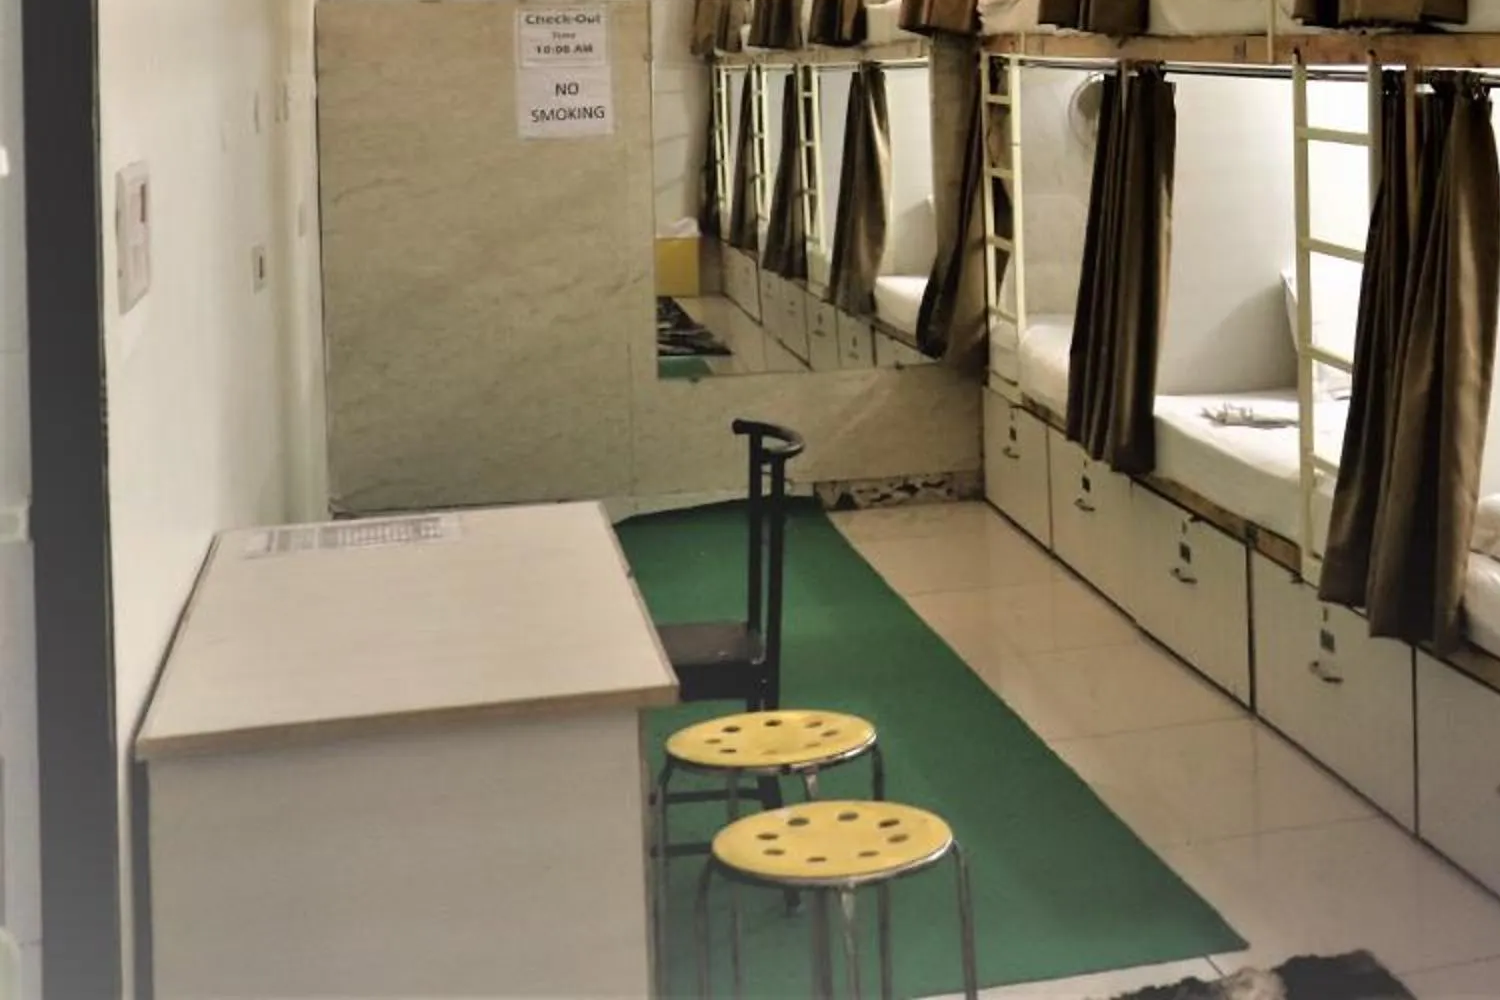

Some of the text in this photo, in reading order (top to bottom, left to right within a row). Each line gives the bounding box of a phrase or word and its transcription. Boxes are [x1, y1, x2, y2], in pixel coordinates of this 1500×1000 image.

[525, 13, 601, 24] Check-Out
[573, 43, 594, 53] AM
[555, 83, 579, 96] NO
[531, 105, 606, 123] SMOKING
